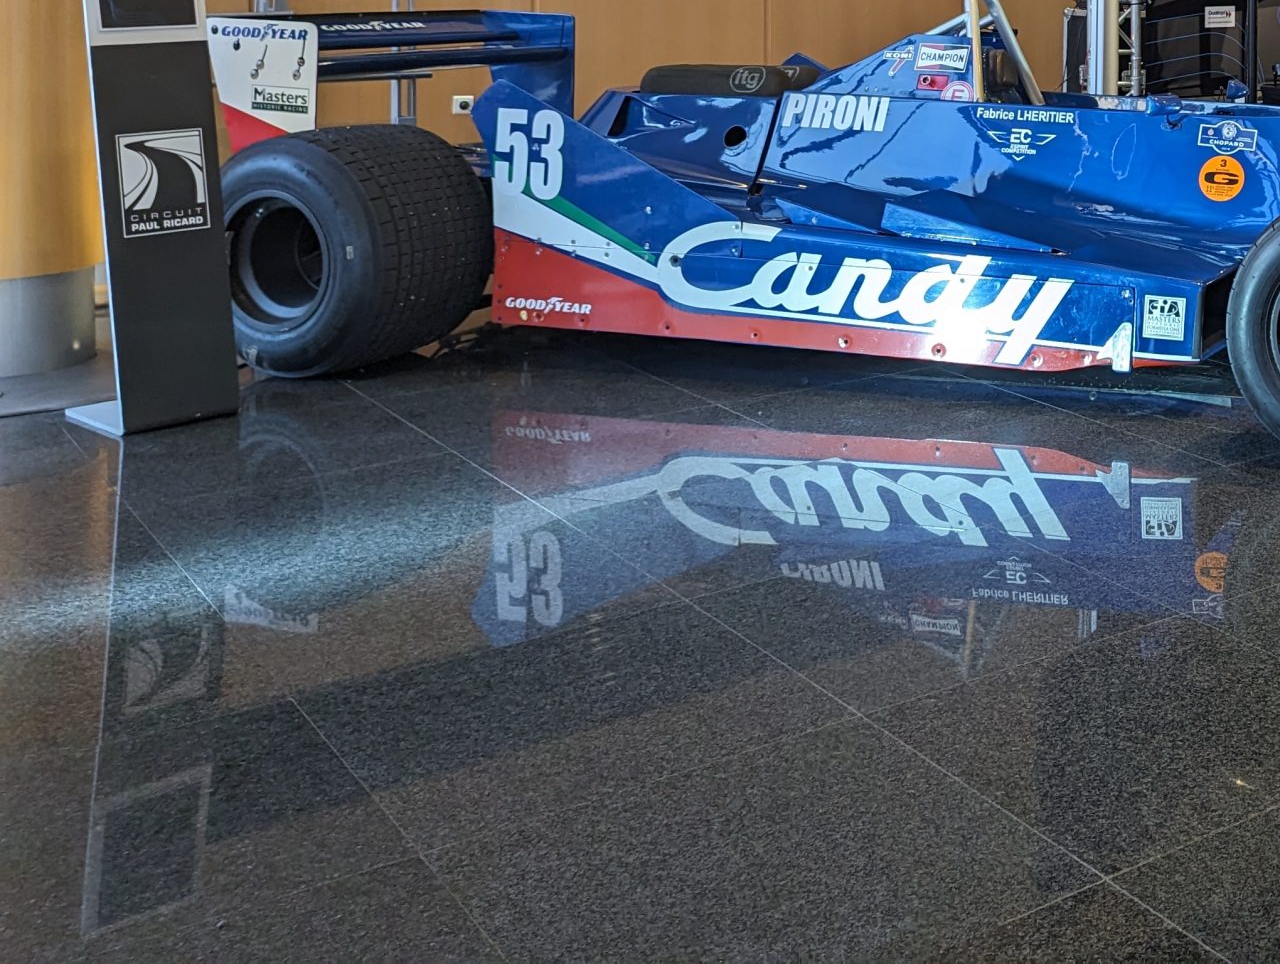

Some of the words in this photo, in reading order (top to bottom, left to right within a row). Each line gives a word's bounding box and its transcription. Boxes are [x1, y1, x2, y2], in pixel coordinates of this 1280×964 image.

[886, 51, 912, 59] KONI
[920, 50, 965, 64] CHAMPION
[734, 68, 760, 90] itg
[253, 88, 308, 107] Masters
[781, 93, 890, 132] PIRONI
[977, 107, 1015, 121] Fabrice
[1017, 110, 1074, 124] LHERITIER
[1010, 128, 1032, 143] EC
[495, 106, 565, 201] 53
[1220, 159, 1227, 167] 3
[131, 207, 203, 222] CIRCUIT
[131, 221, 161, 232] PAUL
[163, 216, 204, 228] RICARD
[656, 220, 1076, 367] Candy
[1147, 316, 1181, 324] MASTERS
